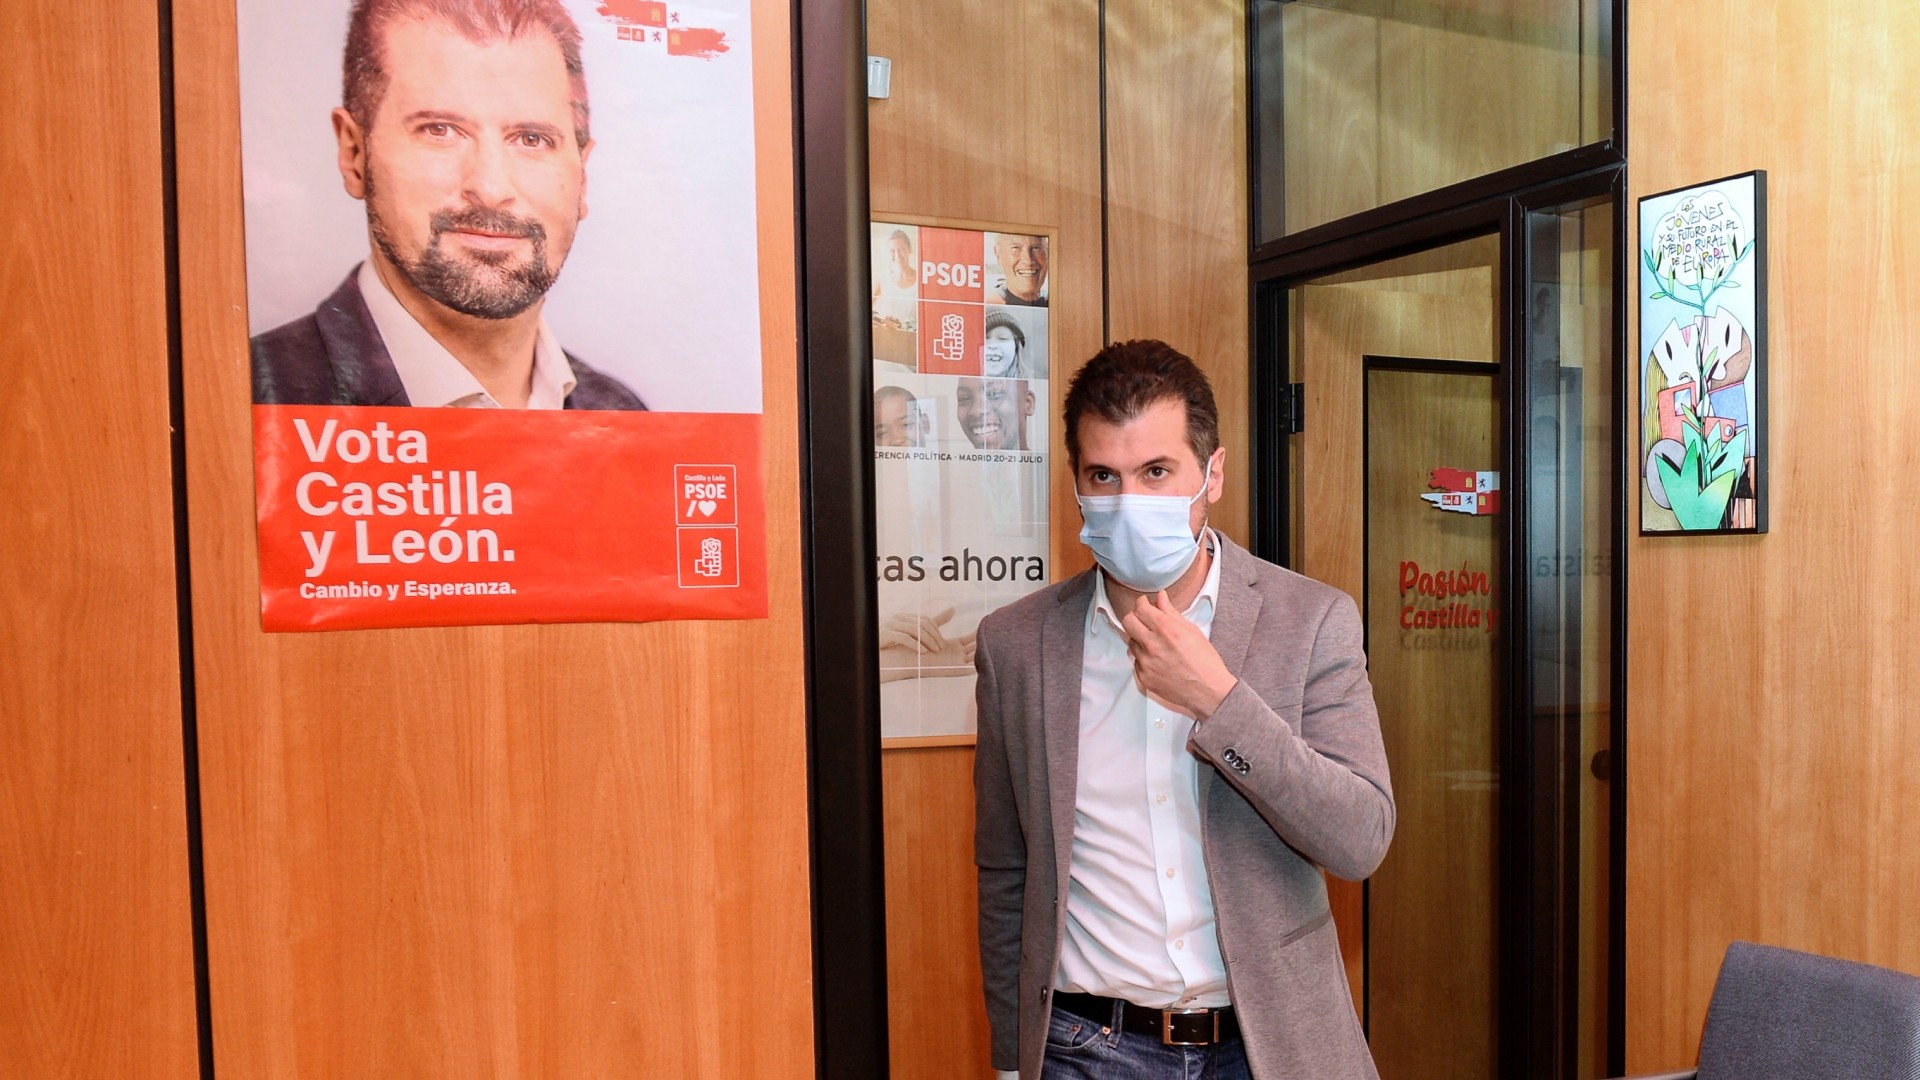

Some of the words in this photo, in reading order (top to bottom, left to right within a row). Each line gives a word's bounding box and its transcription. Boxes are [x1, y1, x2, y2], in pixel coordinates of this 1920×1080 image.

[1681, 199, 1695, 213] LOS
[1677, 225, 1707, 243] FUTURO
[1710, 220, 1722, 233] EN
[1726, 219, 1739, 231] EL
[1662, 241, 1692, 260] MEDIO
[1694, 234, 1727, 254] RURAL
[1671, 256, 1680, 266] DE
[1682, 247, 1730, 273] EUROPA
[922, 261, 981, 288] PSOE
[293, 418, 428, 464] Vota
[913, 451, 952, 461] POLÍTICA
[958, 454, 992, 463] MADRID
[993, 454, 1017, 463] 20-21
[1018, 455, 1043, 464] JULIO
[295, 470, 513, 516] Castilla
[684, 483, 727, 499] PSOE
[301, 530, 336, 578] y
[355, 517, 515, 564] León.
[939, 547, 1044, 582] ahora
[299, 580, 383, 600] Cambio
[386, 584, 400, 602] y
[404, 580, 517, 600] Esperanza.
[1399, 560, 1491, 600] Pasión
[1399, 603, 1482, 630] Castilla
[1484, 607, 1500, 634] y
